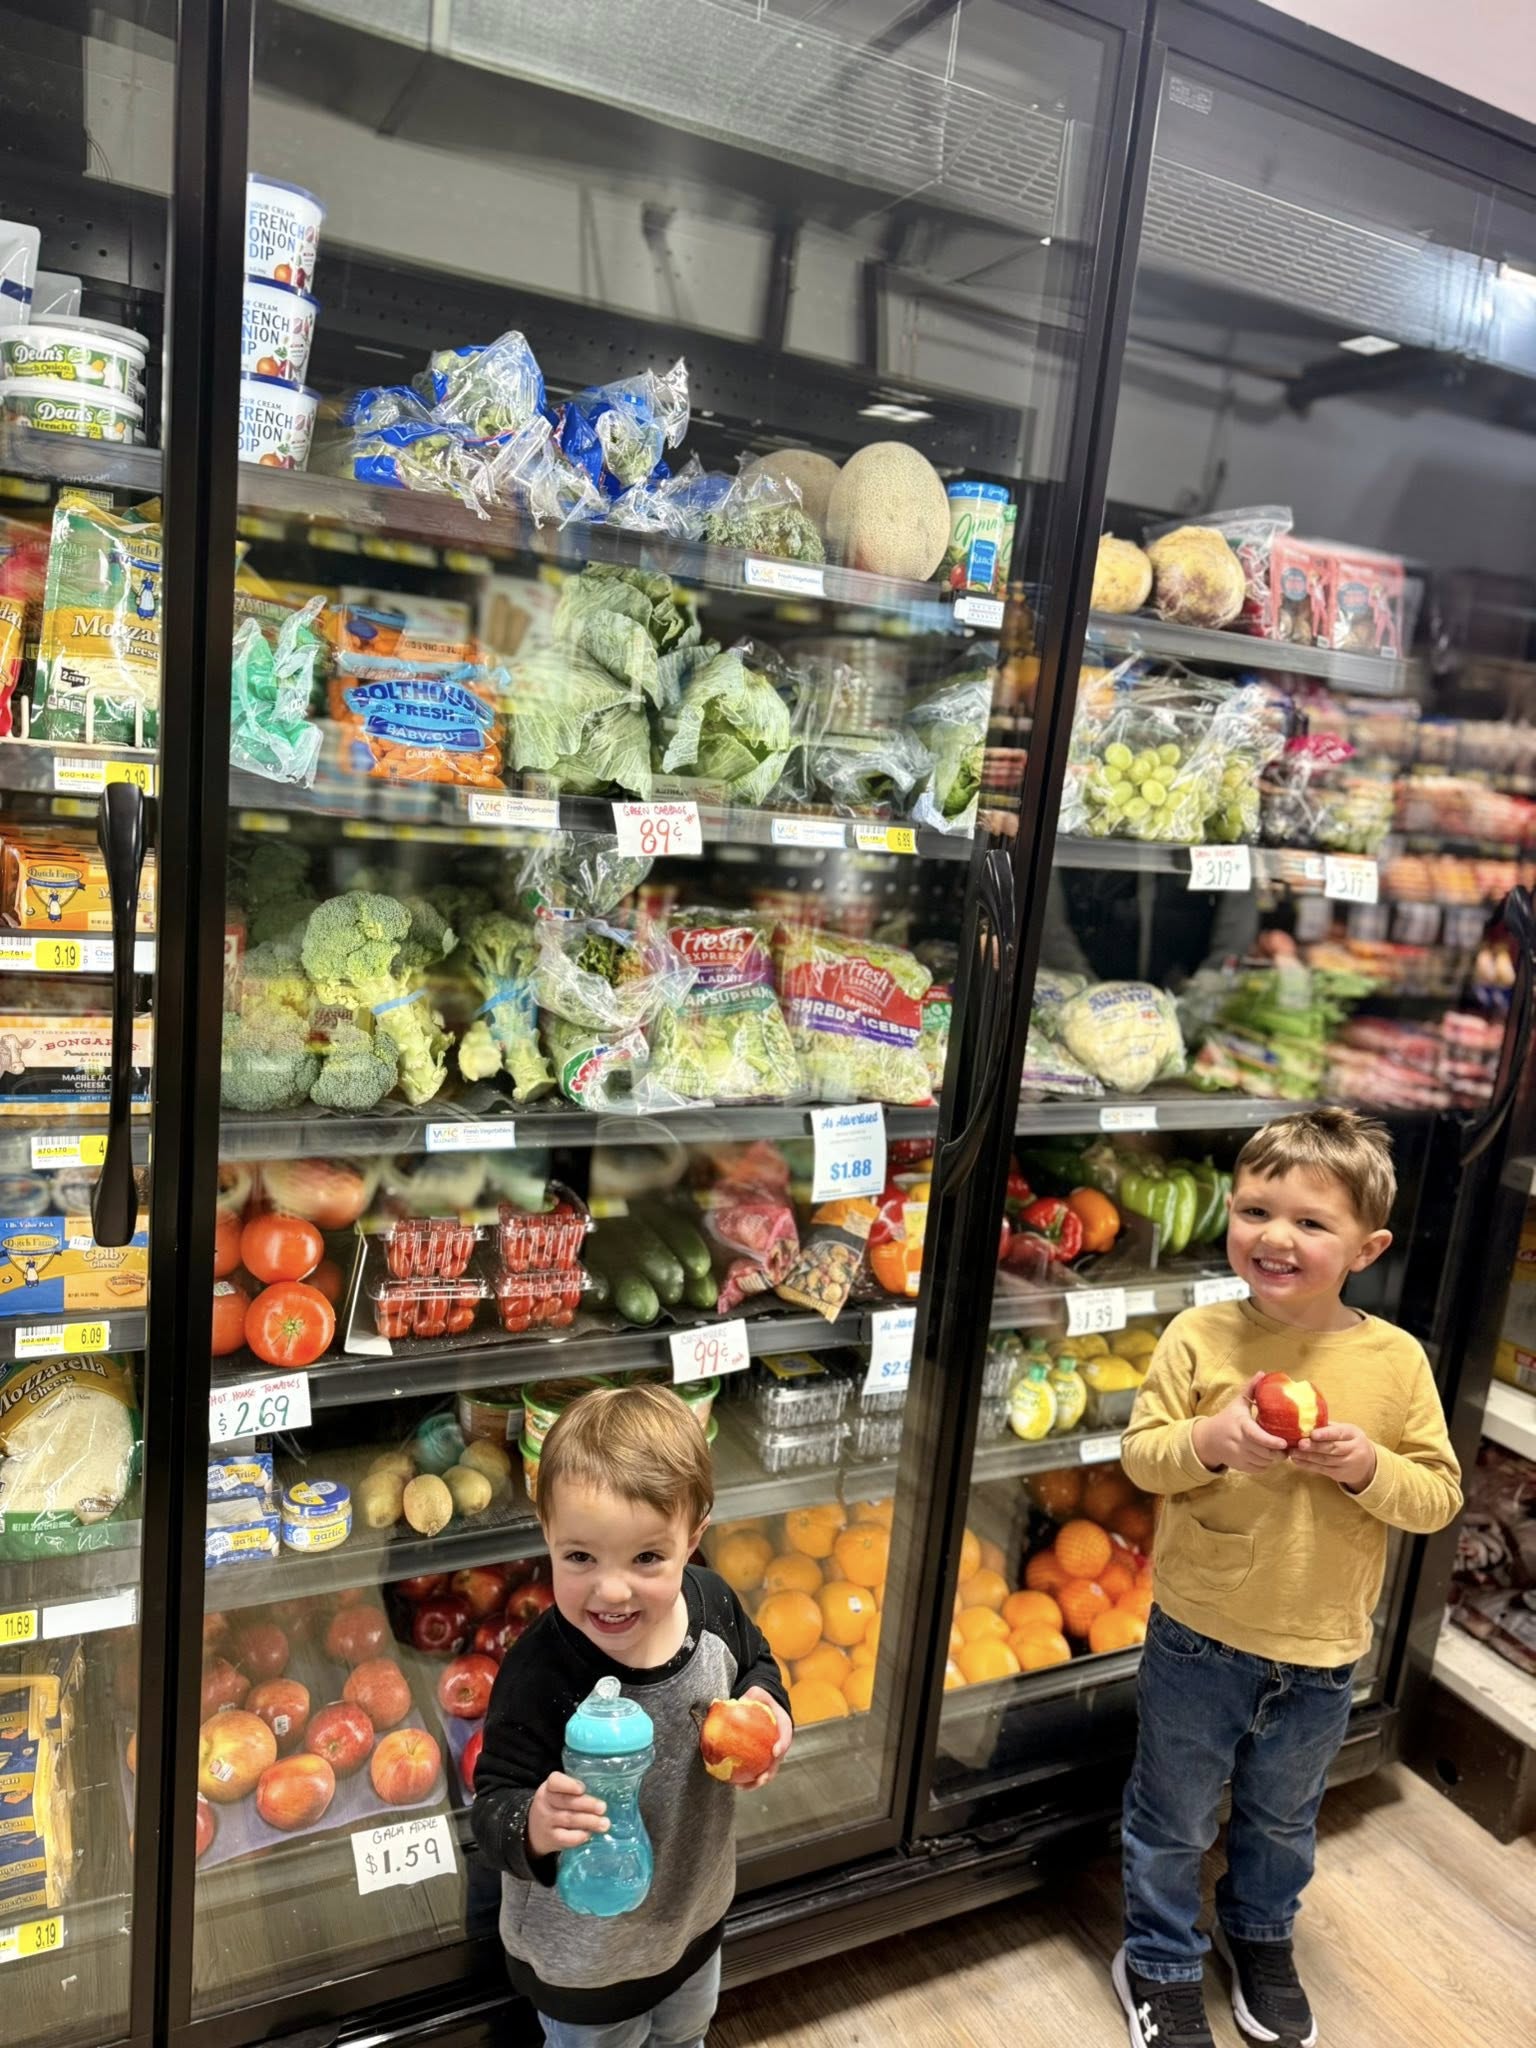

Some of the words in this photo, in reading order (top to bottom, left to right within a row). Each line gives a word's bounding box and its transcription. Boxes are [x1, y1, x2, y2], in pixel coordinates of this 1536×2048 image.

[271, 206, 295, 217] CREAM
[249, 210, 305, 240] FRENCH
[249, 226, 296, 252] ONION
[249, 243, 275, 261] DIP
[253, 300, 278, 312] CREAM
[242, 308, 290, 332] RENCH
[242, 324, 280, 345] NION
[14, 344, 64, 363] Dean's
[241, 338, 257, 355] IP
[40, 362, 71, 372] Onion
[38, 402, 93, 422] Dean's
[240, 397, 255, 405] OUR
[257, 400, 282, 410] CREAM
[36, 421, 68, 431] French
[69, 423, 99, 433] Oon
[124, 645, 160, 660] heese
[61, 670, 69, 680] 2
[352, 680, 490, 723] BOLTHOUSE
[395, 703, 456, 722] FRESH
[386, 723, 463, 743] BABY-CUT
[405, 750, 447, 760] CARROTS
[124, 768, 146, 790] 319
[475, 801, 502, 812] WIC
[523, 806, 556, 814] Vegetables
[623, 804, 650, 816] GREEN
[653, 805, 688, 815] CABBAGE
[30, 867, 55, 878] Dutch
[56, 869, 79, 879] Farms
[681, 929, 746, 954] Fresh
[54, 945, 77, 966] 3.19
[685, 952, 743, 961] EXPRESS
[698, 975, 724, 984] ALAD
[849, 960, 891, 991] Fresh
[849, 977, 885, 998] EXPRESS
[791, 999, 857, 1024] SHREDS
[861, 1016, 920, 1041] ICEBER
[45, 1037, 140, 1051] BONGAS
[831, 1159, 872, 1181] $1.88
[84, 1248, 128, 1264] Colby
[81, 1328, 102, 1344] 6.09
[0, 1354, 109, 1418] Mozzarella
[28, 1375, 75, 1404] Cheese
[209, 1392, 228, 1407] HOT
[217, 1395, 290, 1437] $2.69
[207, 1468, 222, 1477] PICE
[208, 1475, 225, 1484] ORLD
[233, 1535, 263, 1547] garlic
[313, 1527, 344, 1542] garlic
[5, 1616, 30, 1637] 11.69
[372, 1826, 405, 1845] GALA
[409, 1818, 439, 1834] APPLE
[365, 1837, 441, 1876] $1.59
[36, 1923, 56, 1948] 3.19
